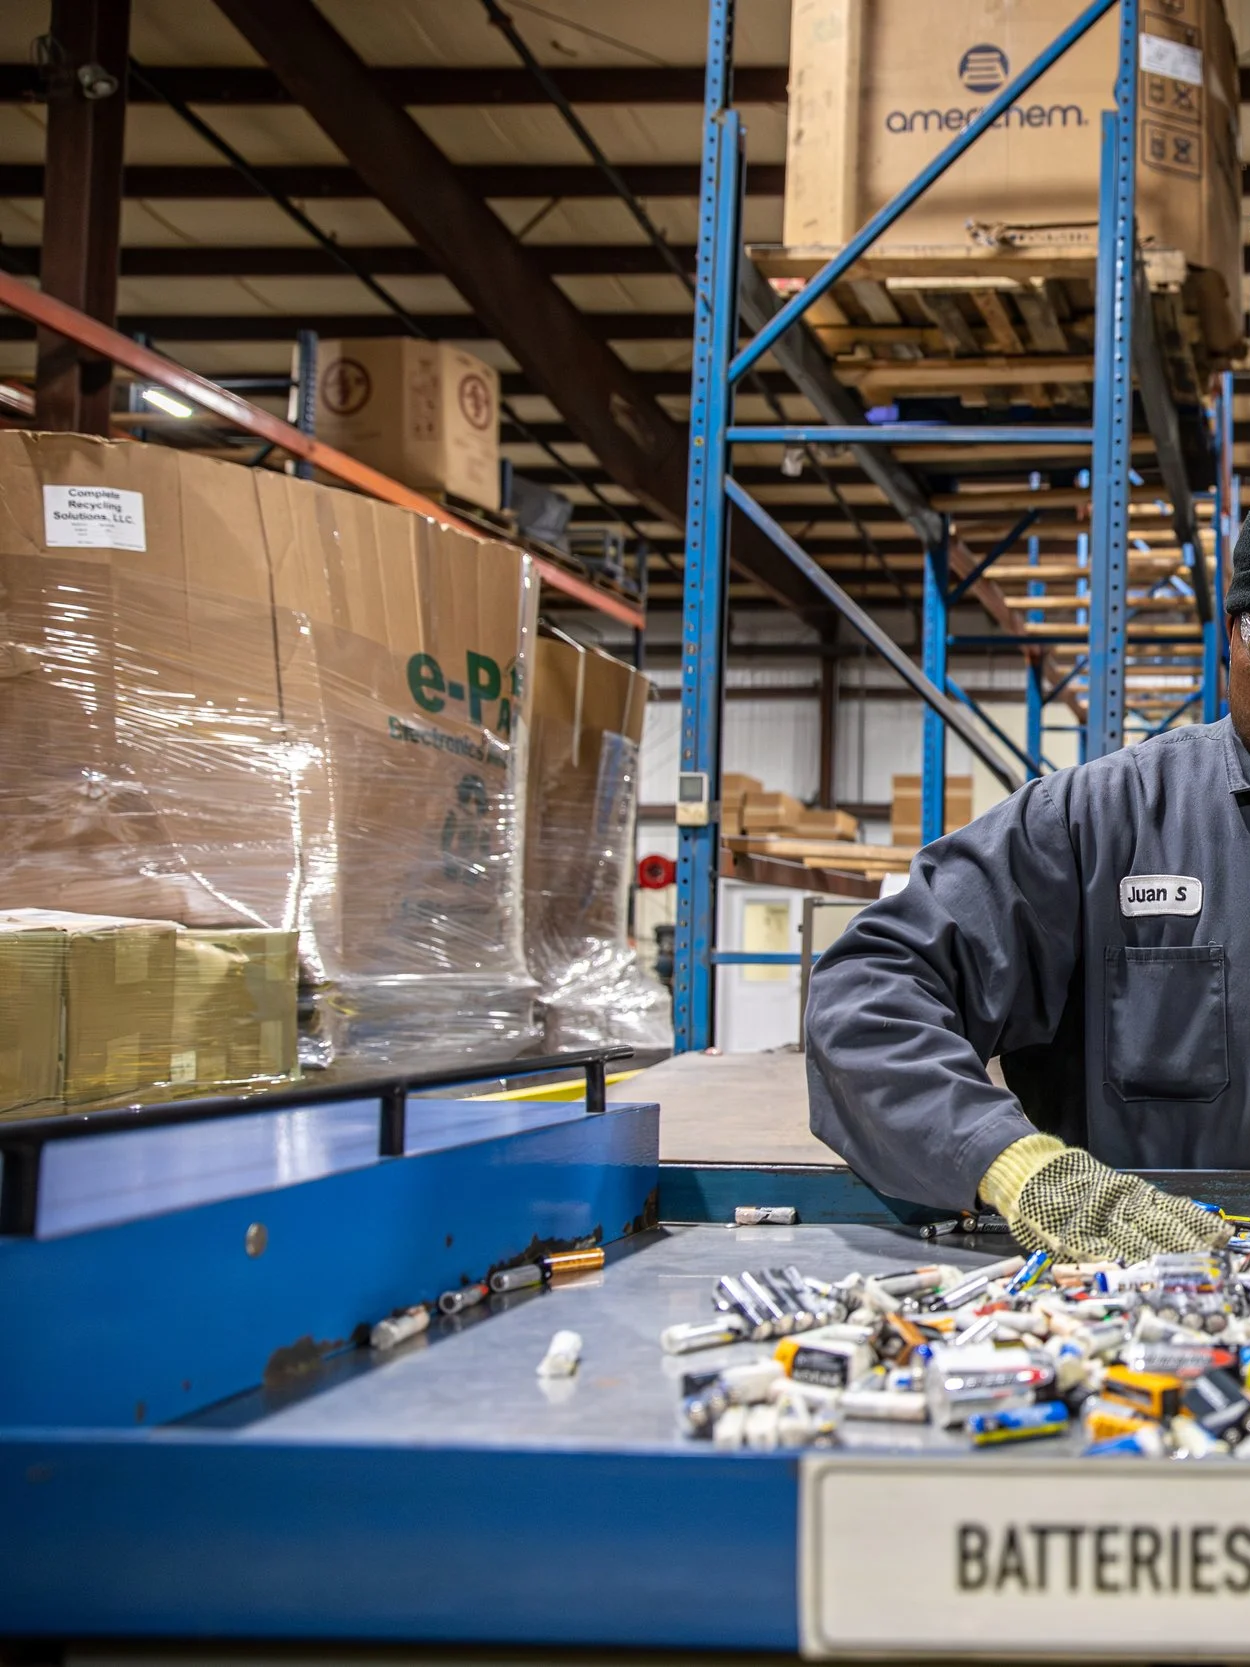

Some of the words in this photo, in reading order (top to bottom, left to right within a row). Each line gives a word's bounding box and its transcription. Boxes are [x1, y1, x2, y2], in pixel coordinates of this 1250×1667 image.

[68, 488, 120, 499] Complete
[68, 500, 122, 513] Recycling
[1127, 886, 1168, 903] Juan
[1174, 885, 1187, 902] S
